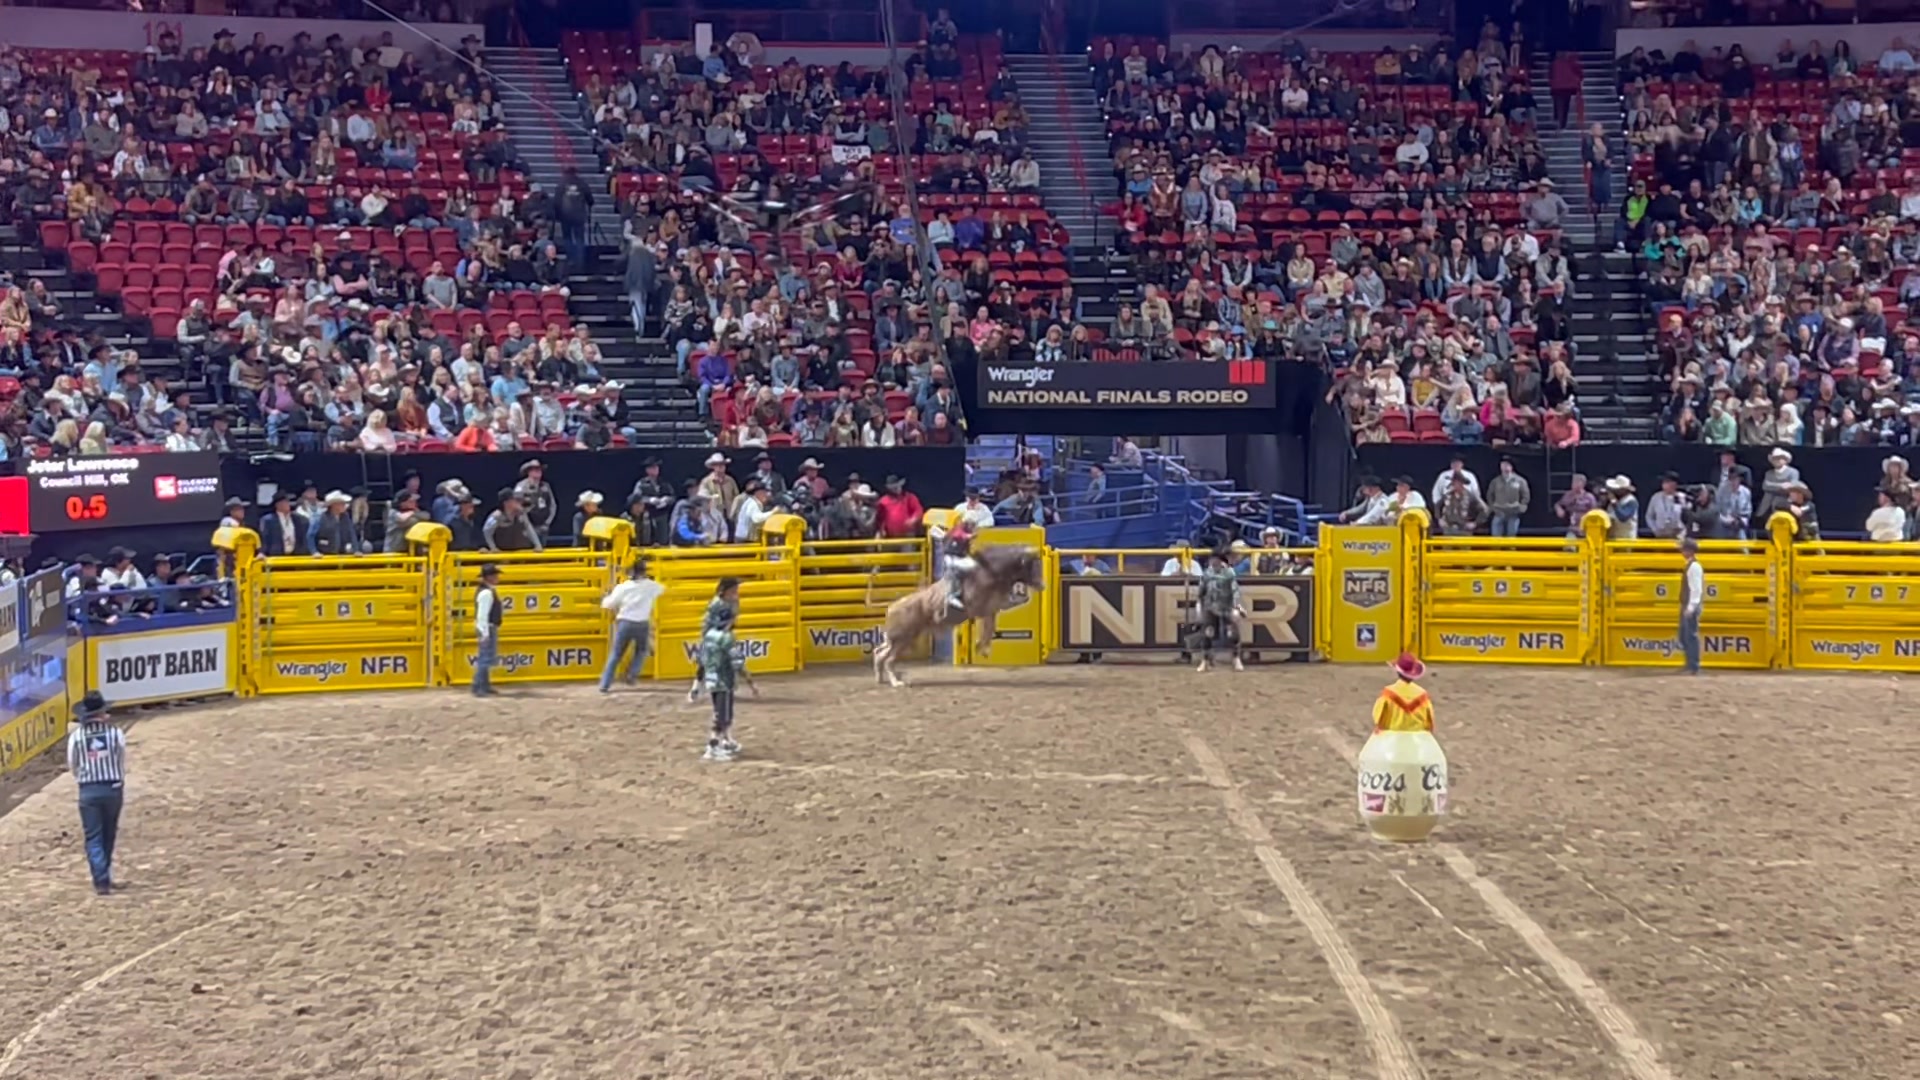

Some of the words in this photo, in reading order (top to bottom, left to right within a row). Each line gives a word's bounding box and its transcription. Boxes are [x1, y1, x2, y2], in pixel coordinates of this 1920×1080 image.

[988, 366, 1054, 387] Wrangler
[988, 390, 1091, 404] NATIONAL
[1097, 390, 1171, 404] FINALS
[1177, 389, 1249, 404] RODEO
[66, 494, 108, 520] 0.5
[1342, 541, 1391, 555] Wrangler
[1347, 580, 1387, 592] NFR
[1473, 581, 1482, 593] 5
[1521, 581, 1531, 593] 5
[1656, 584, 1666, 596] 6
[1706, 584, 1717, 596] 6
[1845, 586, 1856, 598] 7
[1897, 586, 1908, 599] 7
[315, 604, 323, 616] 1
[366, 602, 373, 615] 1
[504, 597, 513, 610] 2
[551, 596, 560, 609] 2
[1069, 585, 1300, 645] NFR
[810, 626, 888, 654] Wrangl
[1440, 634, 1506, 653] Wrangler
[1519, 633, 1564, 649] NFR
[1624, 637, 1685, 657] Wrangle
[1704, 636, 1750, 653] NFR
[1812, 640, 1881, 660] Wrangler
[106, 653, 161, 684] BOOT
[164, 647, 218, 677] BARN
[277, 662, 348, 682] Wrangler
[361, 656, 408, 674] NFR
[468, 653, 535, 673] Wngler
[547, 648, 593, 666] NFR
[1361, 772, 1407, 792] oors
